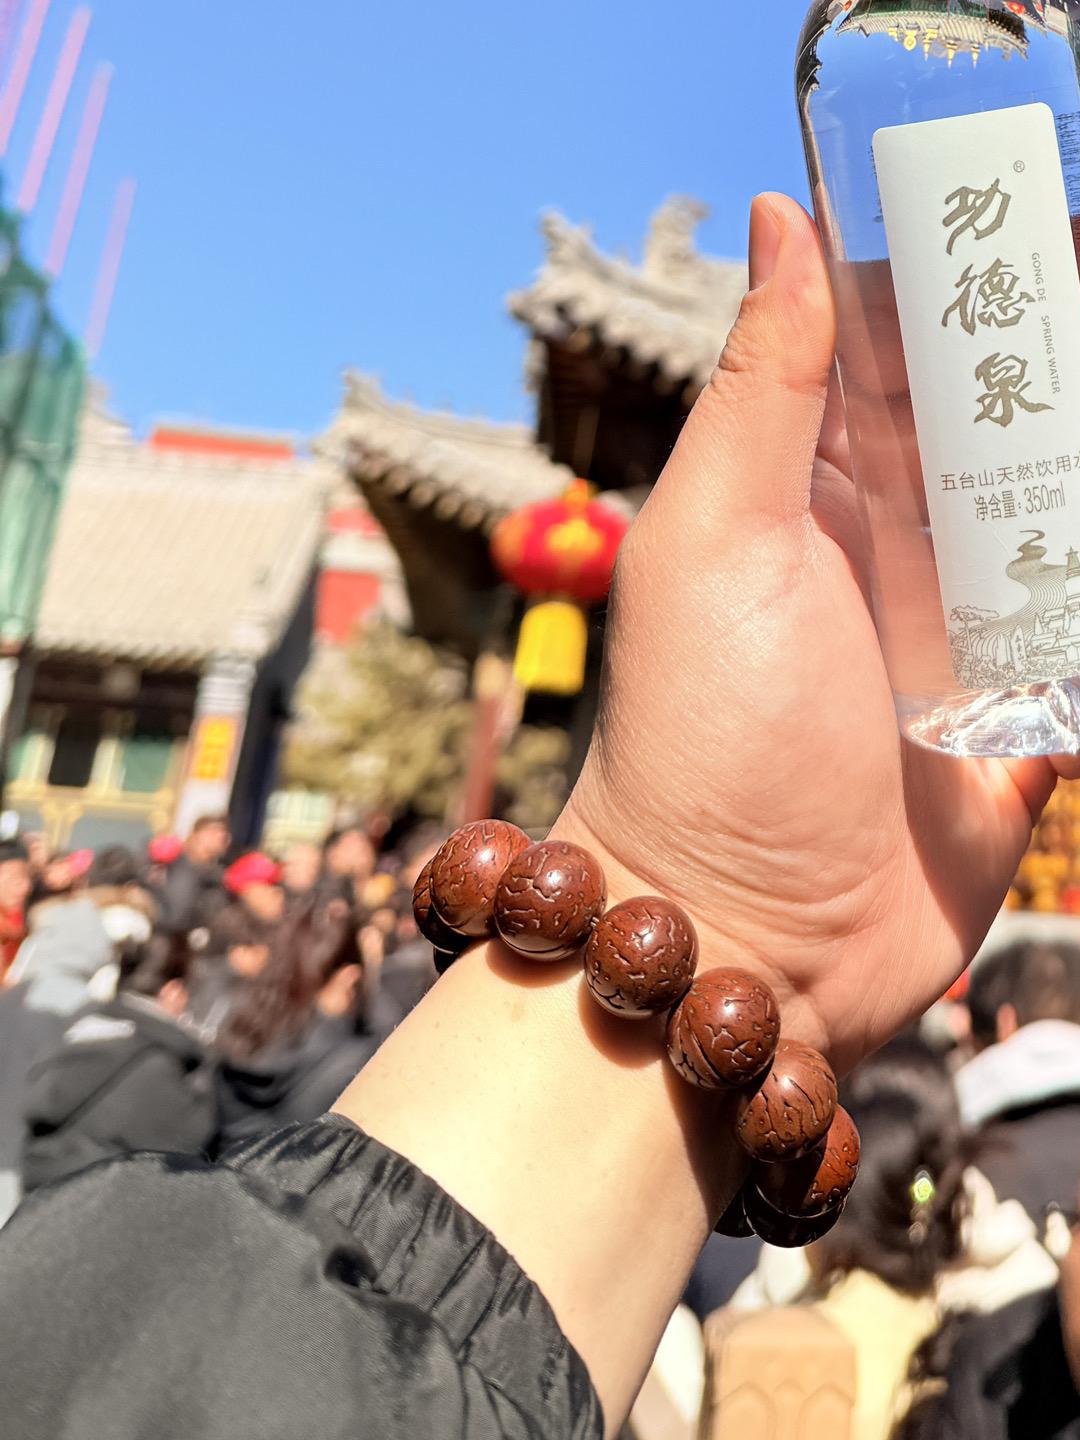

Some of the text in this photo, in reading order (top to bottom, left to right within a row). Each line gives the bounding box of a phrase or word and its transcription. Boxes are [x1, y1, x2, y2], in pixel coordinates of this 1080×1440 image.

[941, 177, 1055, 427] 功德泉
[1031, 252, 1061, 394] GONG DE SPRING WATER
